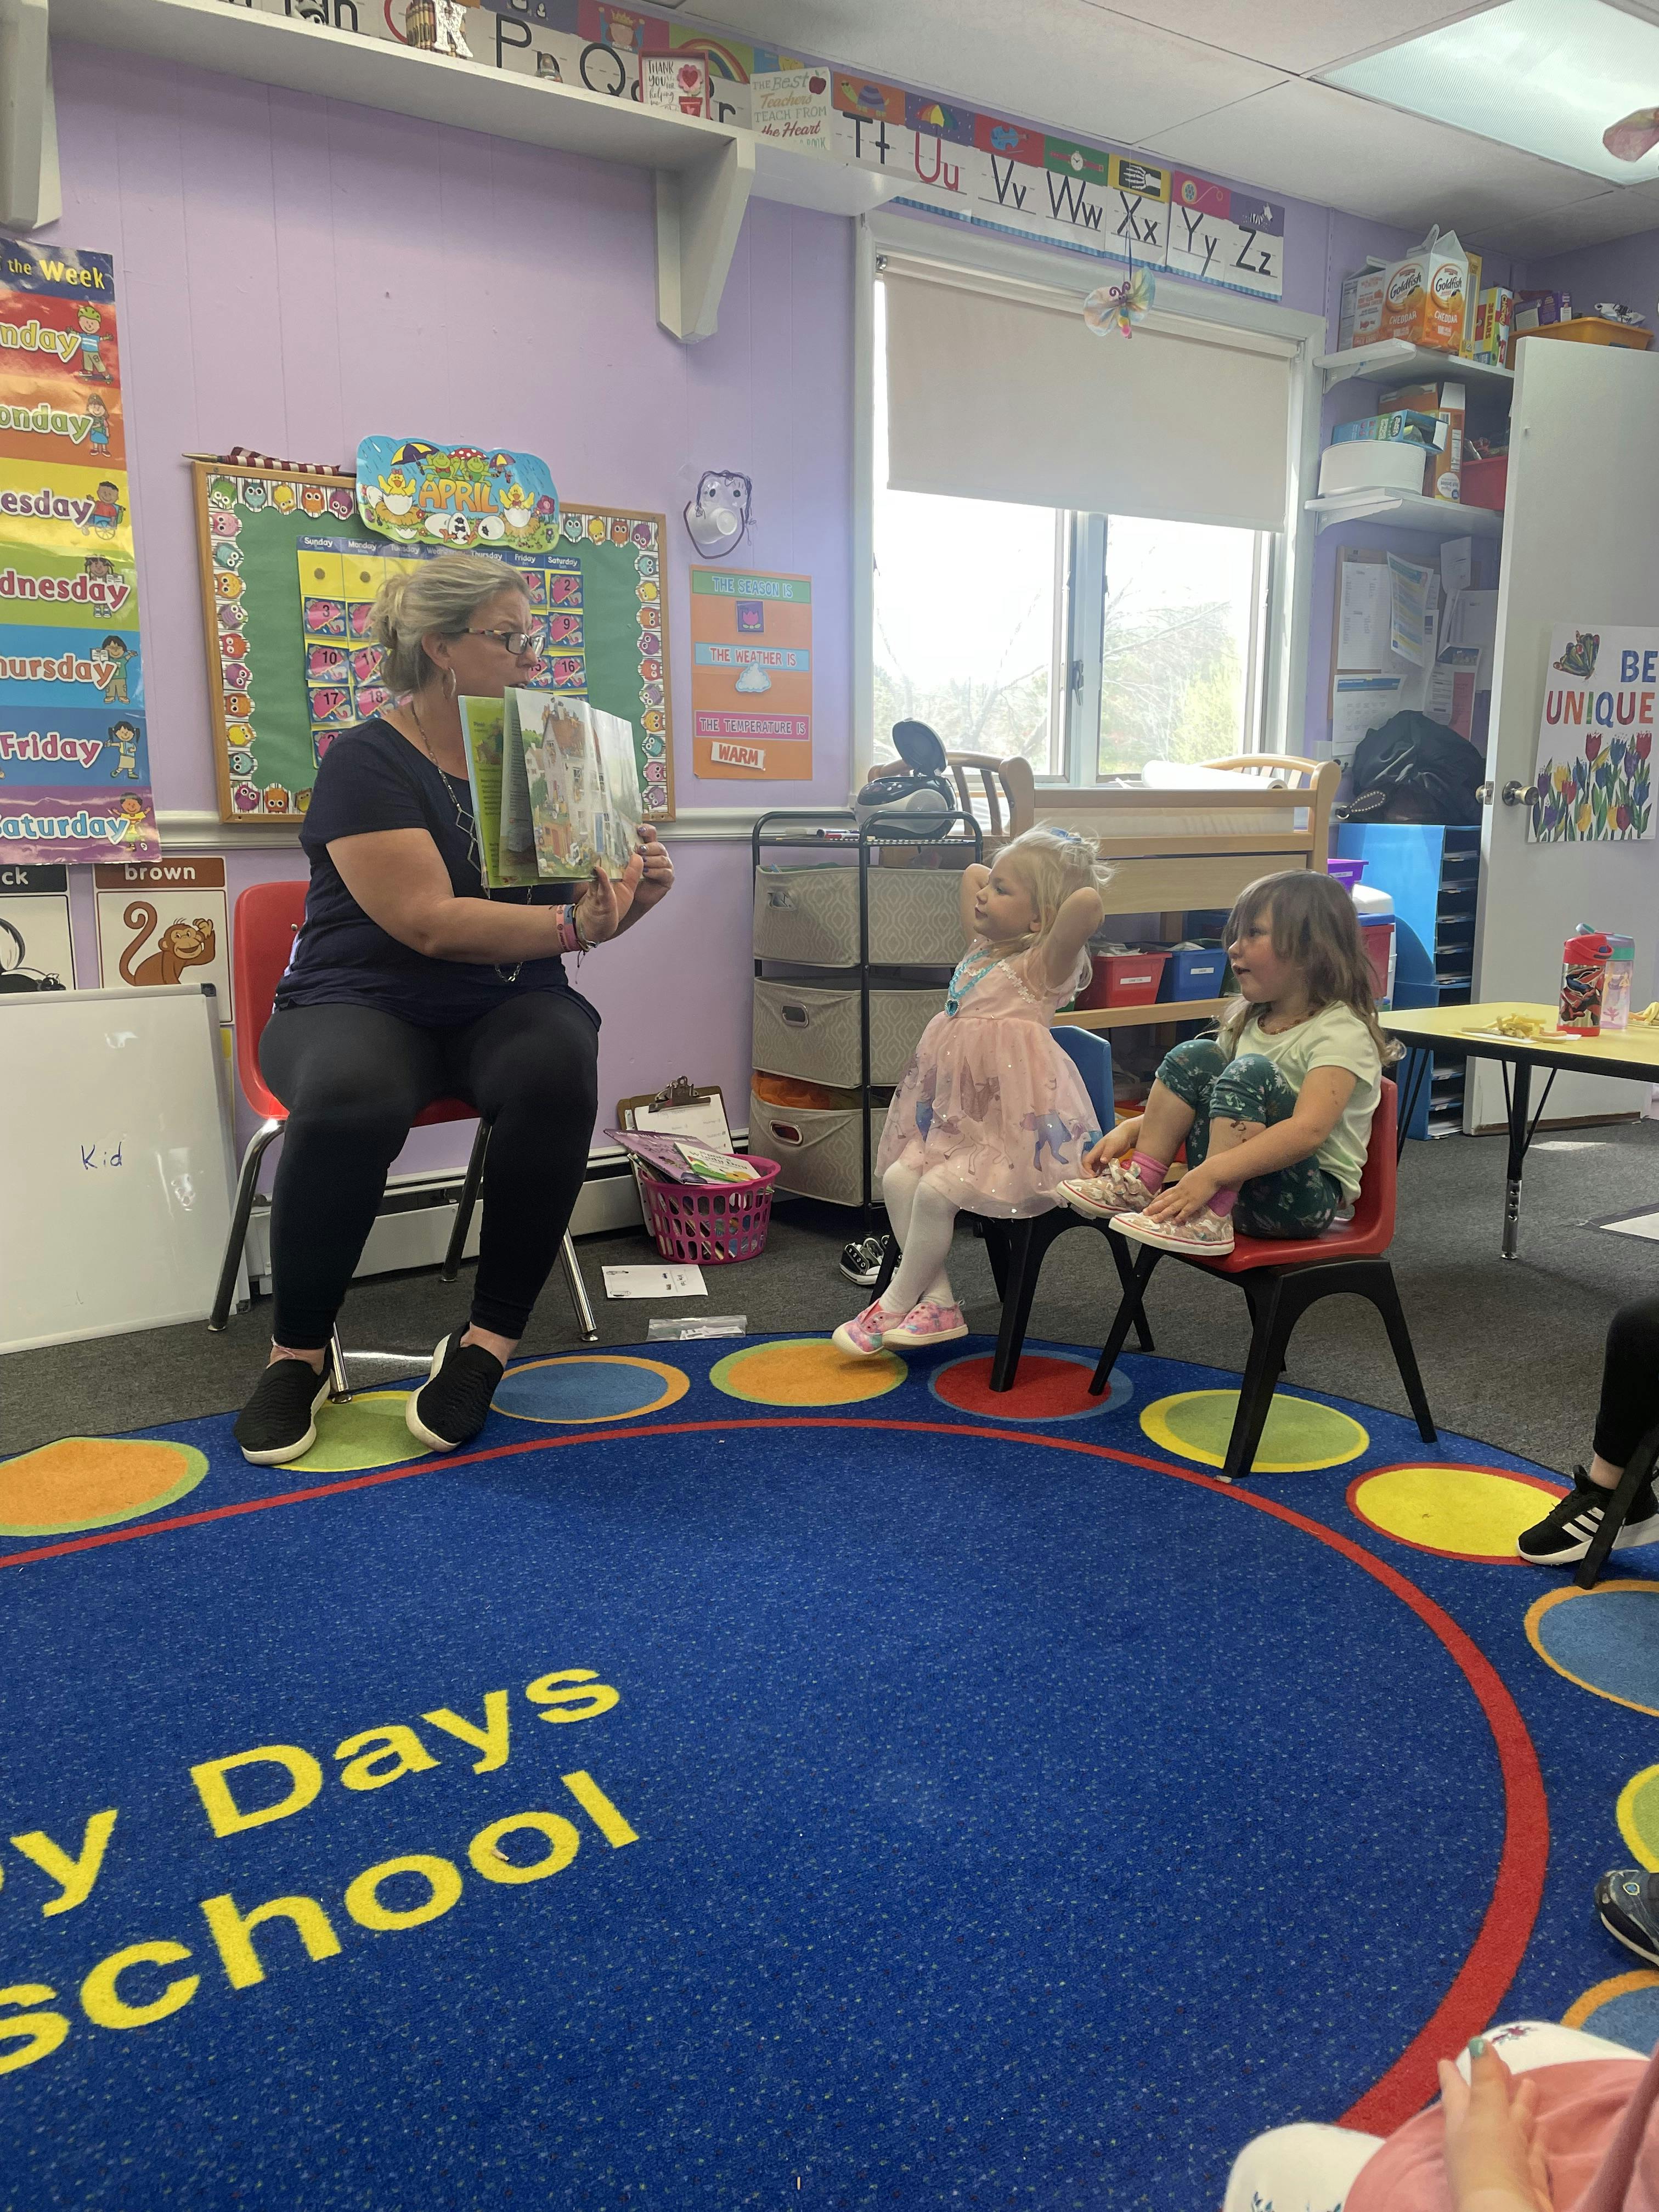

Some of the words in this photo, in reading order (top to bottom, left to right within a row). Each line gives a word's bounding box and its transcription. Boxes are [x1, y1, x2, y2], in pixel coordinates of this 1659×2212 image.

[648, 60, 674, 75] THANK
[753, 80, 770, 90] THE
[760, 91, 812, 109] Teachers
[754, 109, 791, 123] TEACH
[795, 105, 827, 119] FROM
[761, 123, 780, 137] the
[782, 120, 821, 137] Heart
[842, 111, 890, 165] Tt
[915, 132, 960, 191] Uu
[991, 154, 1027, 210] Vv
[1046, 171, 1103, 229] Ww
[1117, 191, 1158, 245] Xx
[1182, 206, 1217, 276] Yy
[1235, 225, 1271, 275] Zz
[8, 258, 32, 275] the
[39, 259, 105, 290] Week
[1390, 272, 1422, 300] Goldfish
[1436, 276, 1462, 292] Goldfish
[1389, 311, 1417, 325] CHEDDAR
[1434, 310, 1458, 324] CHEDDAR
[419, 478, 499, 514] APRIL
[304, 537, 333, 548] Sunday
[348, 540, 377, 551] Monday
[391, 544, 420, 554] Tuesday
[471, 550, 503, 560] Thursday
[515, 553, 536, 563] Friday
[548, 556, 578, 567] Saturday
[564, 579, 571, 591] 2
[713, 577, 735, 593] THE
[739, 579, 779, 597] SEASON
[782, 583, 794, 598] IS
[322, 604, 330, 618] 3
[563, 618, 571, 630] 9
[322, 650, 337, 665] 10
[362, 651, 377, 665] 11
[710, 647, 730, 662] THE
[735, 650, 782, 665] WEATHER
[786, 653, 797, 666] IS
[562, 660, 575, 673] 16
[1620, 650, 1658, 683] BE
[323, 692, 338, 706] 17
[368, 690, 383, 704] 18
[1545, 690, 1656, 729] UNIQUE
[699, 718, 719, 731] THE
[724, 720, 792, 734] TEMPERATURE
[797, 723, 805, 735] IS
[0, 734, 101, 766] Friday
[719, 743, 759, 766] WARM
[125, 864, 196, 881] brown
[81, 1141, 122, 1170] Kid
[190, 1668, 620, 1838] Days
